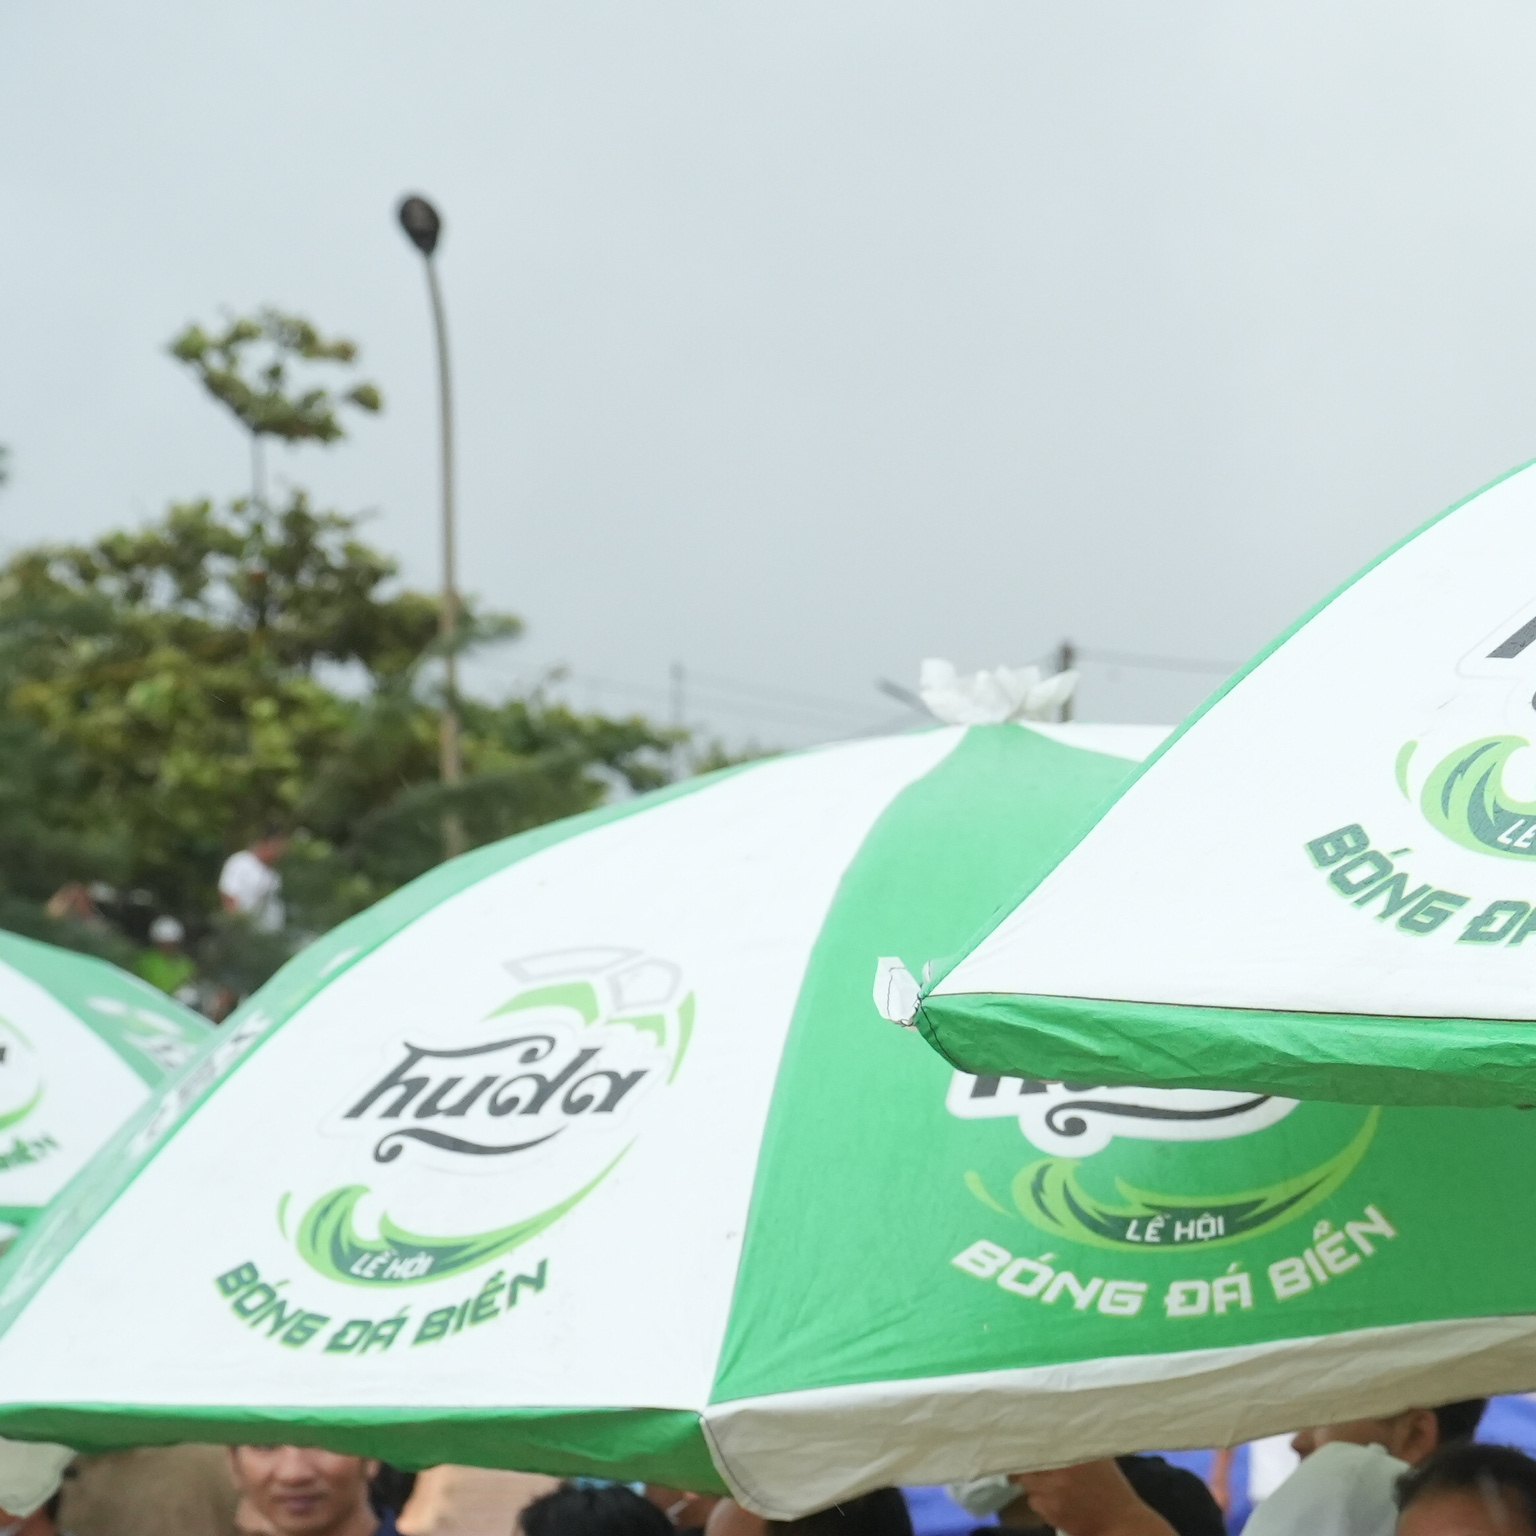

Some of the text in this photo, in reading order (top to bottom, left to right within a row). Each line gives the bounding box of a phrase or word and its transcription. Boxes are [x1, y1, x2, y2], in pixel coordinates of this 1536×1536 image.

[1304, 823, 1472, 936] BÓNG
[342, 1034, 651, 1162] huda
[950, 1204, 1398, 1317] BÓNG ĐÁ BIỂN
[1126, 1213, 1226, 1243] LỄ HỘI
[214, 1261, 331, 1348] BÓNG
[322, 1304, 412, 1355] ĐÁ
